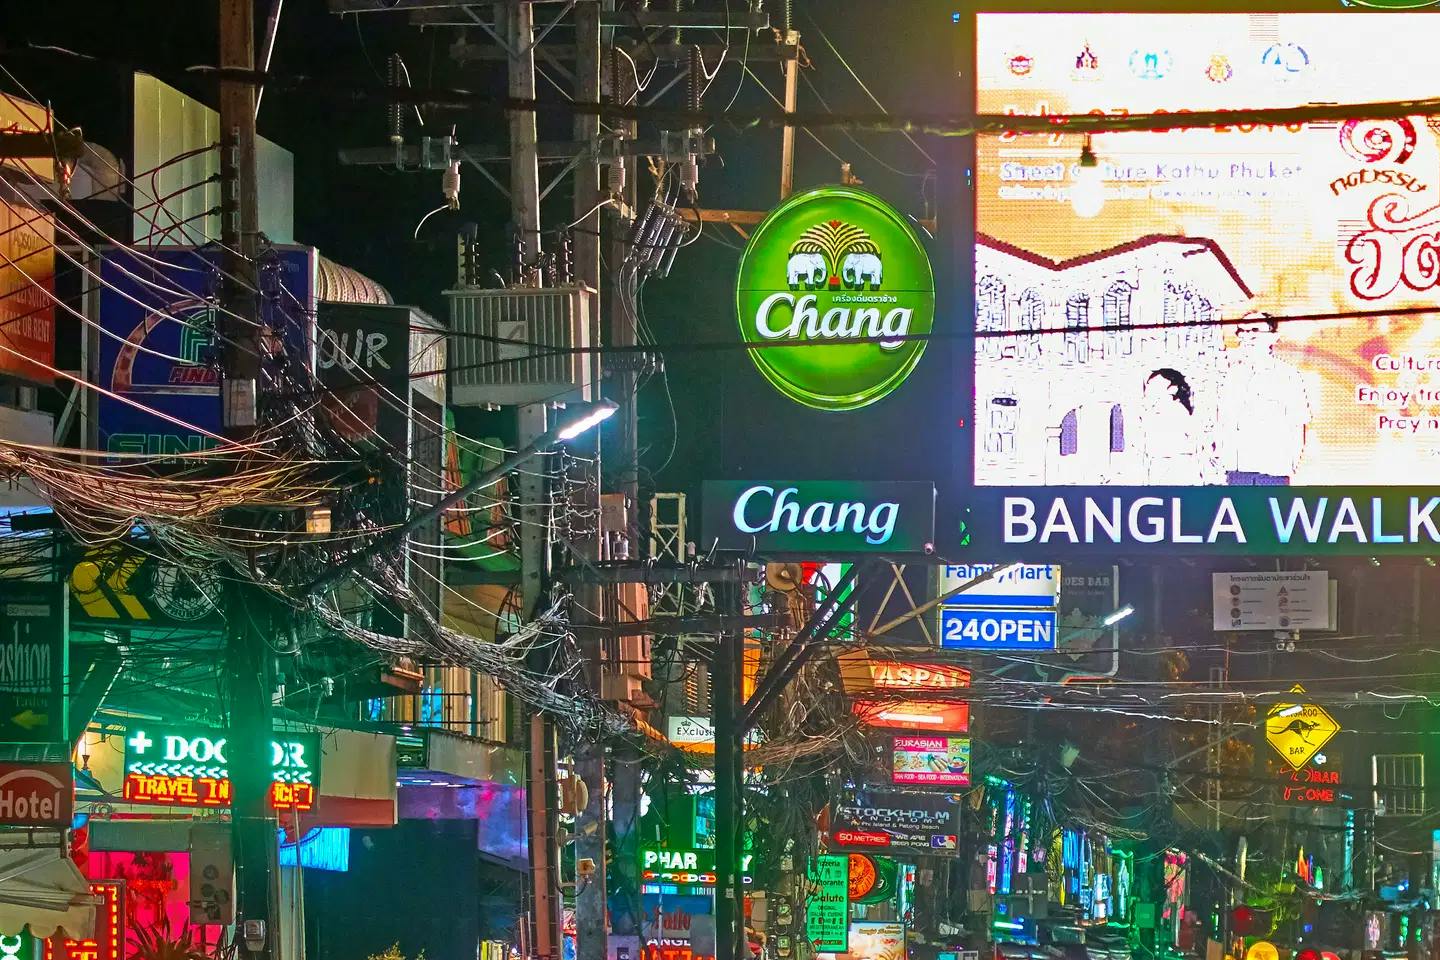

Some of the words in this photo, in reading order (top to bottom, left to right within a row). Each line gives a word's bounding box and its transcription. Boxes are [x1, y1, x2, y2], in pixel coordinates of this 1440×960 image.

[1002, 162, 1064, 179] Street
[755, 292, 912, 350] Chang
[733, 484, 900, 545] Chang
[1004, 496, 1244, 544] BANGLA
[1088, 576, 1110, 586] BAR
[1289, 747, 1305, 755] BAR
[136, 778, 198, 797] TRAVEL
[0, 793, 61, 820] Hotel
